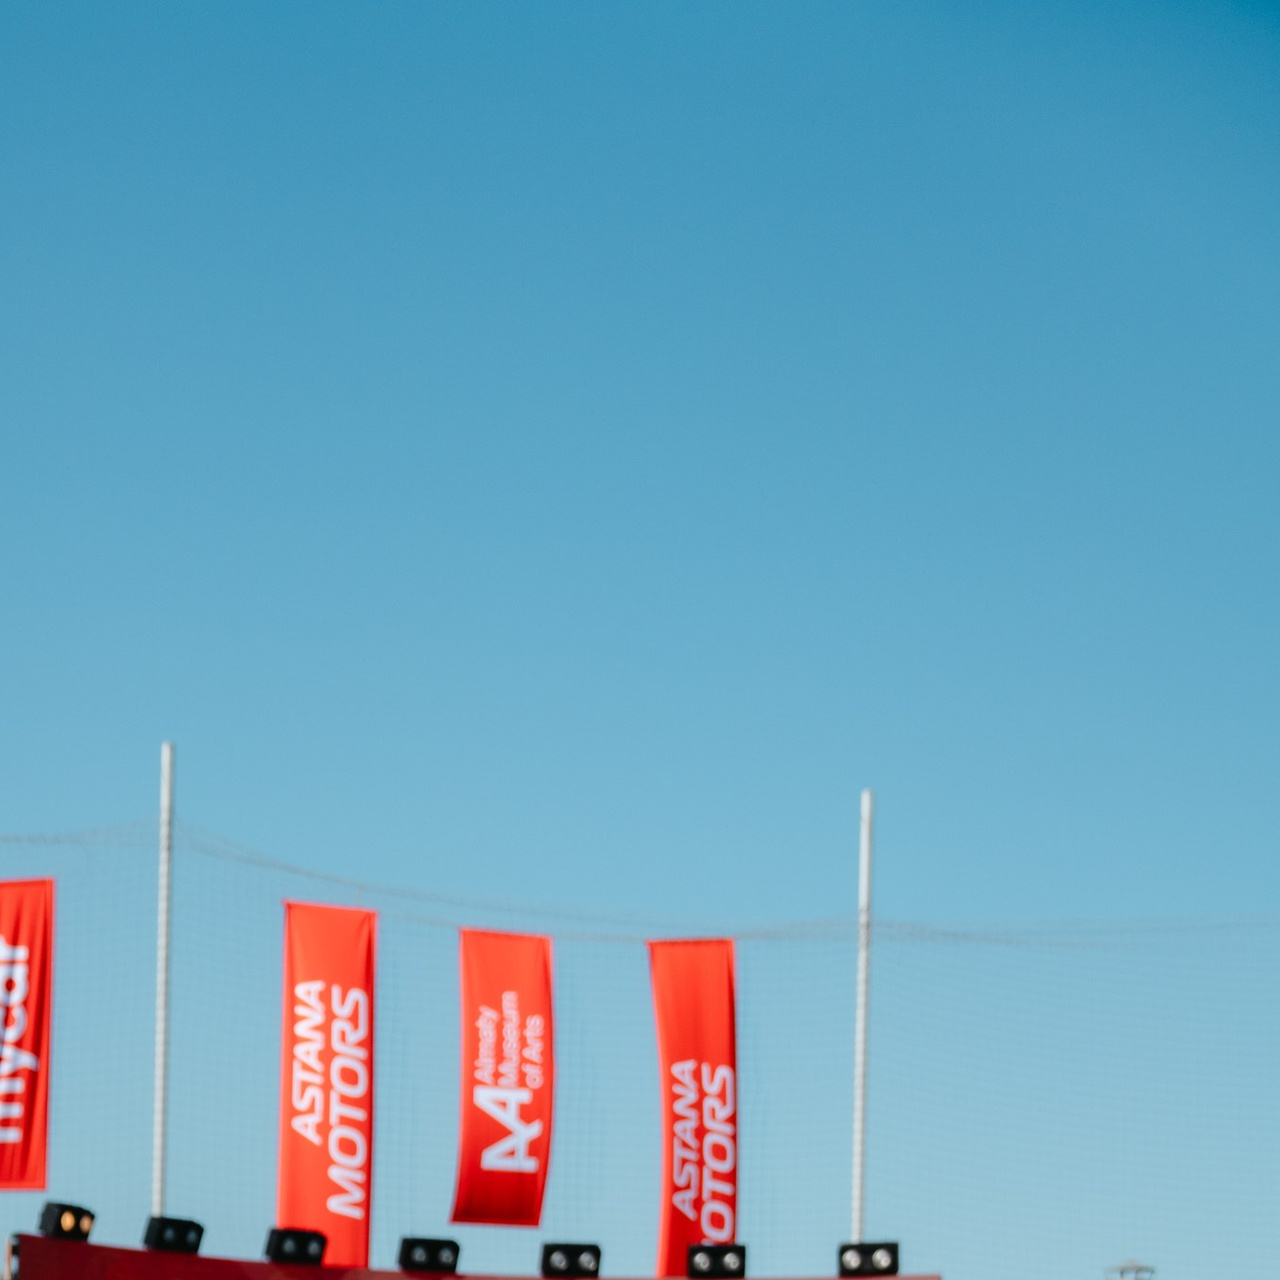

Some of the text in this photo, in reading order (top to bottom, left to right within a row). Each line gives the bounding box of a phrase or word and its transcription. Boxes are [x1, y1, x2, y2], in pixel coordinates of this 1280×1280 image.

[291, 979, 326, 1146] ASTANA
[326, 984, 369, 1220] MOTORS
[473, 1004, 500, 1085] Almaty
[498, 990, 519, 1087] Museum
[522, 1014, 544, 1089] of Arts
[671, 1058, 700, 1221] ASTANA
[700, 1062, 736, 1247] OTORS
